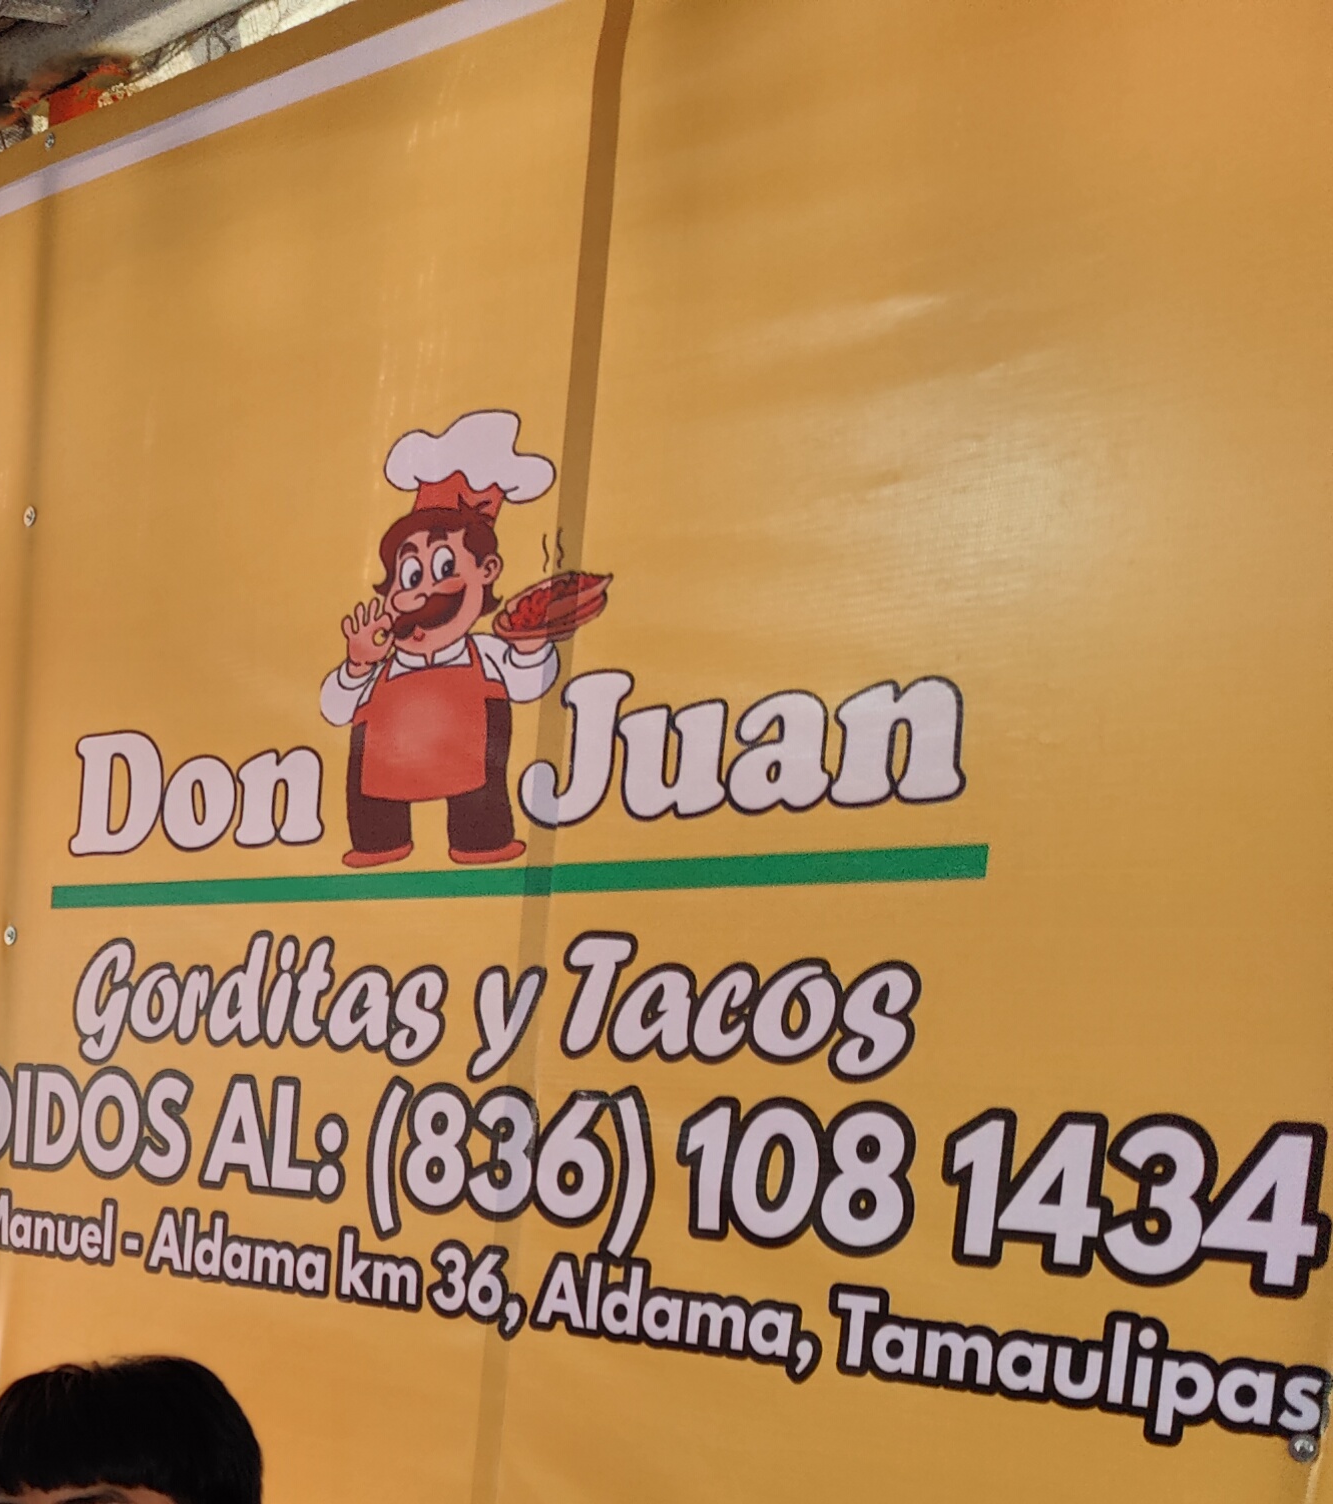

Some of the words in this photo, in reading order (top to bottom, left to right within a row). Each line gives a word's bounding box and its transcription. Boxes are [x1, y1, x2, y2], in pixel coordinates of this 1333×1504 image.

[69, 727, 325, 857] Don
[519, 672, 967, 828] Juan
[73, 932, 446, 1065] Gorditas
[468, 966, 547, 1080] y
[561, 931, 921, 1082] Tacos
[202, 1074, 348, 1200] AL:
[369, 1080, 655, 1259] (836)
[681, 1097, 916, 1257] 108
[943, 1108, 1331, 1300] 1434
[144, 1219, 330, 1296] Aldama
[333, 1242, 425, 1315] km
[428, 1242, 528, 1340] 36,
[531, 1250, 820, 1380] Aldama,
[833, 1288, 1331, 1445] Tamaulipas
